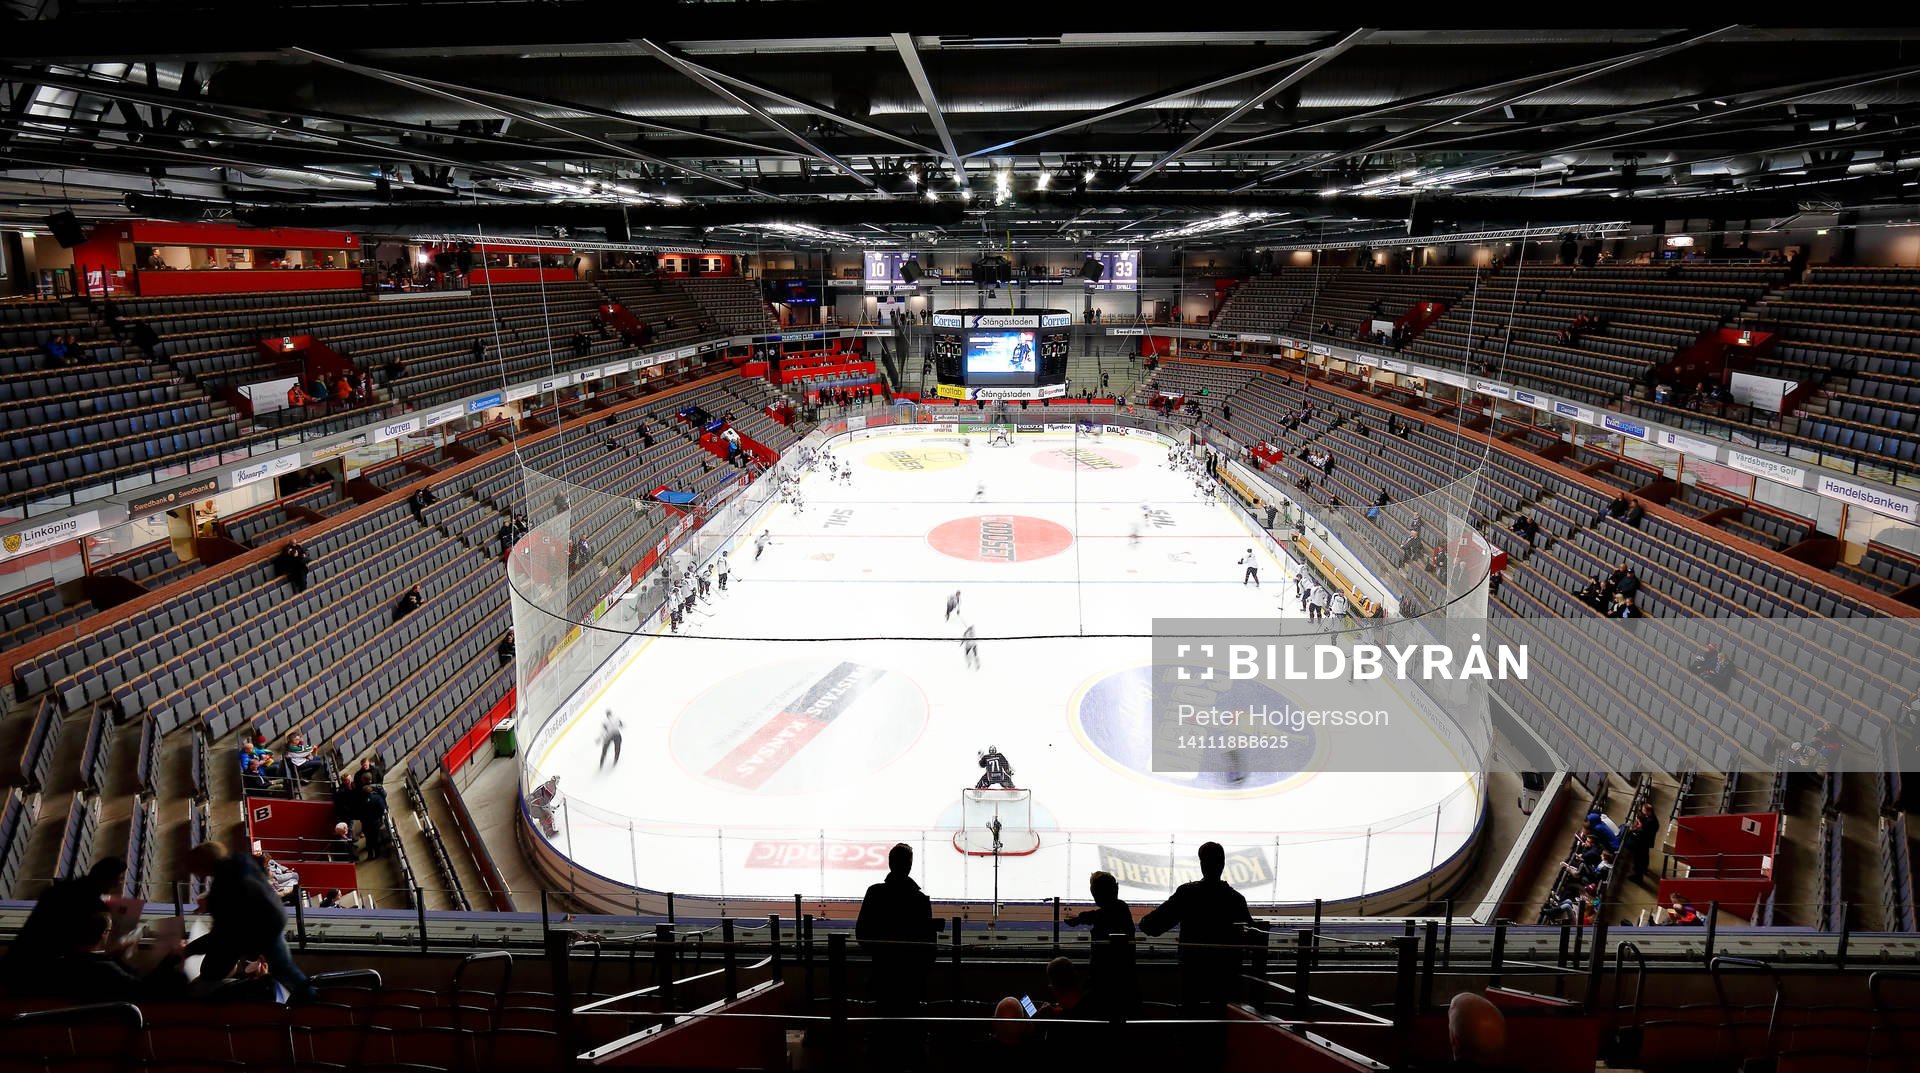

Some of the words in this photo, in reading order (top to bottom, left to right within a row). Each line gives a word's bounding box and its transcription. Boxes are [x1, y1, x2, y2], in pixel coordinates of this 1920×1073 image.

[871, 262, 885, 277] 10
[1115, 261, 1133, 277] 33
[933, 314, 961, 327] Corren
[982, 316, 1034, 328] Stångåstaden
[1041, 313, 1070, 327] Corren
[981, 389, 1031, 400] Stångåstaden
[384, 421, 411, 437] Corren
[1106, 425, 1130, 436] DALOC
[1780, 465, 1797, 477] Golf
[133, 496, 168, 512] Swedbank
[178, 484, 209, 499] Swedbank
[1825, 480, 1909, 514] Handelsbanken
[24, 520, 77, 542] Linköping
[736, 719, 808, 777] KANSAS
[988, 758, 1001, 773] 71
[256, 807, 269, 820] B
[756, 842, 887, 867] Scandic
